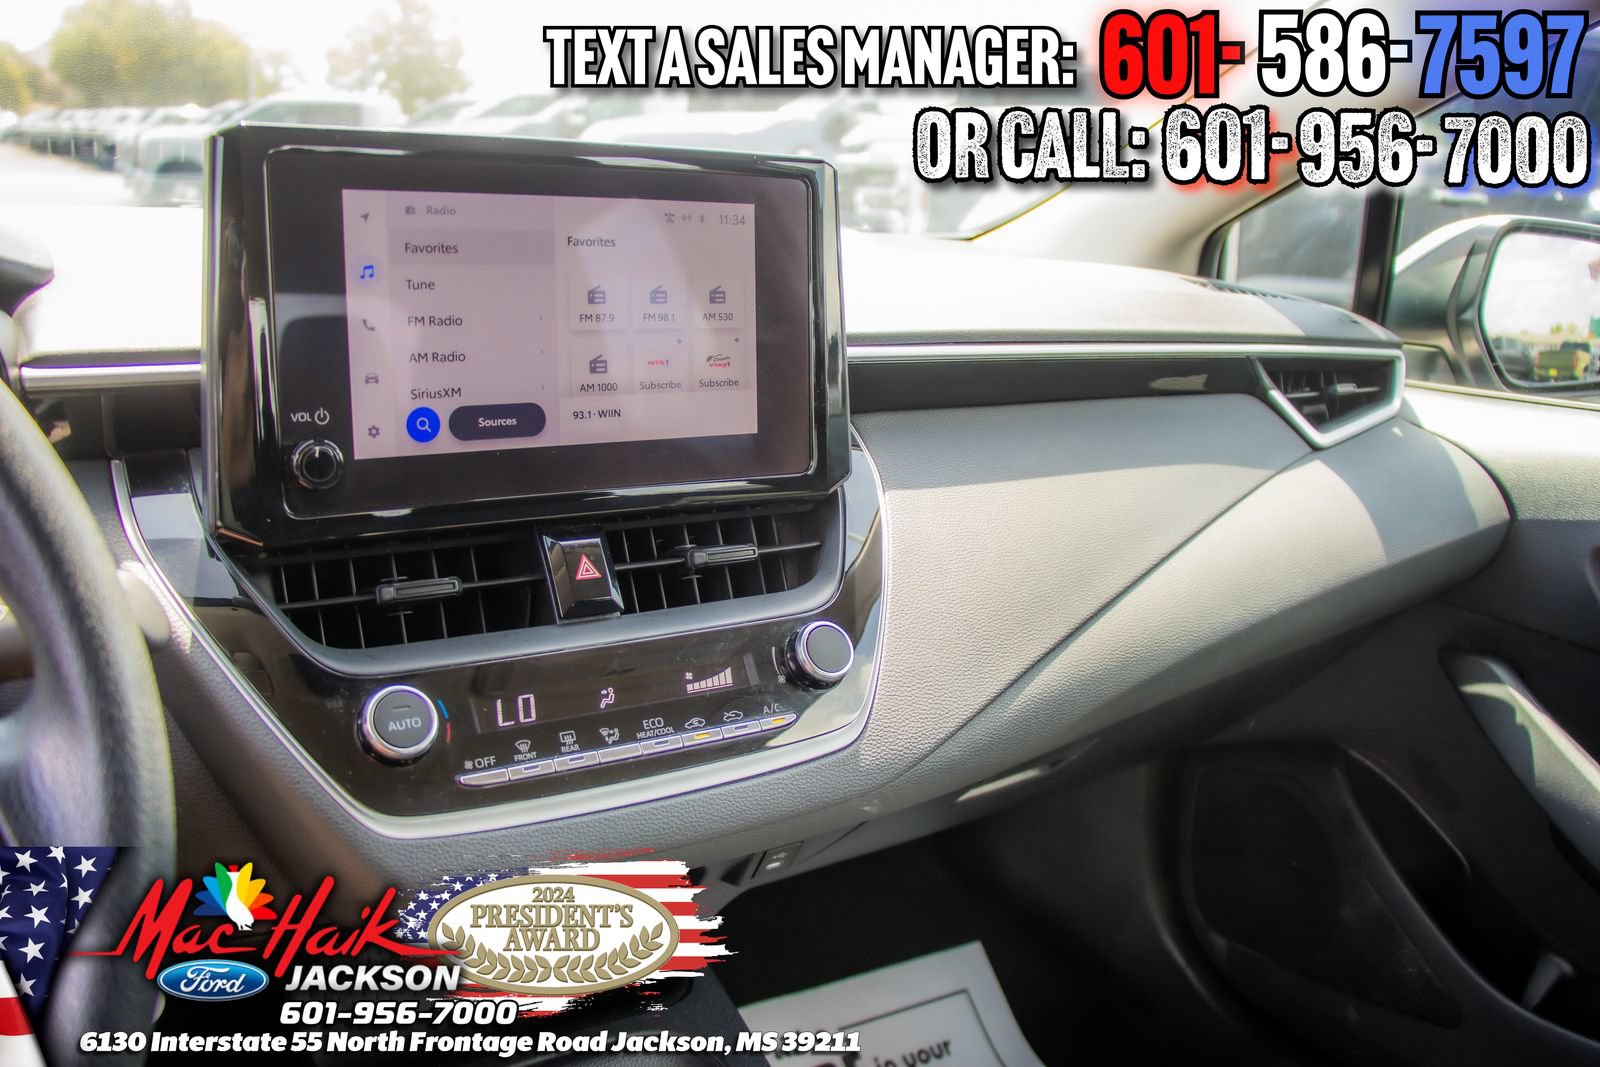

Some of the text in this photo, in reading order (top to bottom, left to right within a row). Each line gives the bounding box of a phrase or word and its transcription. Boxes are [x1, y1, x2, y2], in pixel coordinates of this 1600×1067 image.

[426, 205, 456, 215] Radio
[719, 214, 746, 225] 11:34
[567, 236, 616, 247] Favorites
[404, 242, 459, 254] Favorites
[406, 279, 435, 290] Tune
[407, 315, 463, 327] FM Radio
[579, 313, 615, 323] FM 87.9
[643, 313, 675, 322] FM 98.1
[702, 312, 734, 321] AM 530
[409, 351, 466, 363] AM Radio
[580, 383, 618, 392] AM 1000
[640, 381, 682, 390] Subscribe
[699, 379, 739, 388] Subscribe
[410, 387, 462, 400] SiriusXM
[290, 412, 312, 422] VOL
[598, 409, 621, 418] WIIN
[478, 418, 517, 428] Sources
[496, 693, 537, 727] LO
[763, 703, 781, 714] A/C
[388, 717, 422, 732] AUTO
[642, 718, 664, 729] ECO
[636, 727, 675, 740] HEAT/COOL
[561, 743, 580, 753] REAR
[474, 755, 496, 769] OFF
[513, 751, 538, 762] FRONT
[902, 1040, 951, 1067] your
